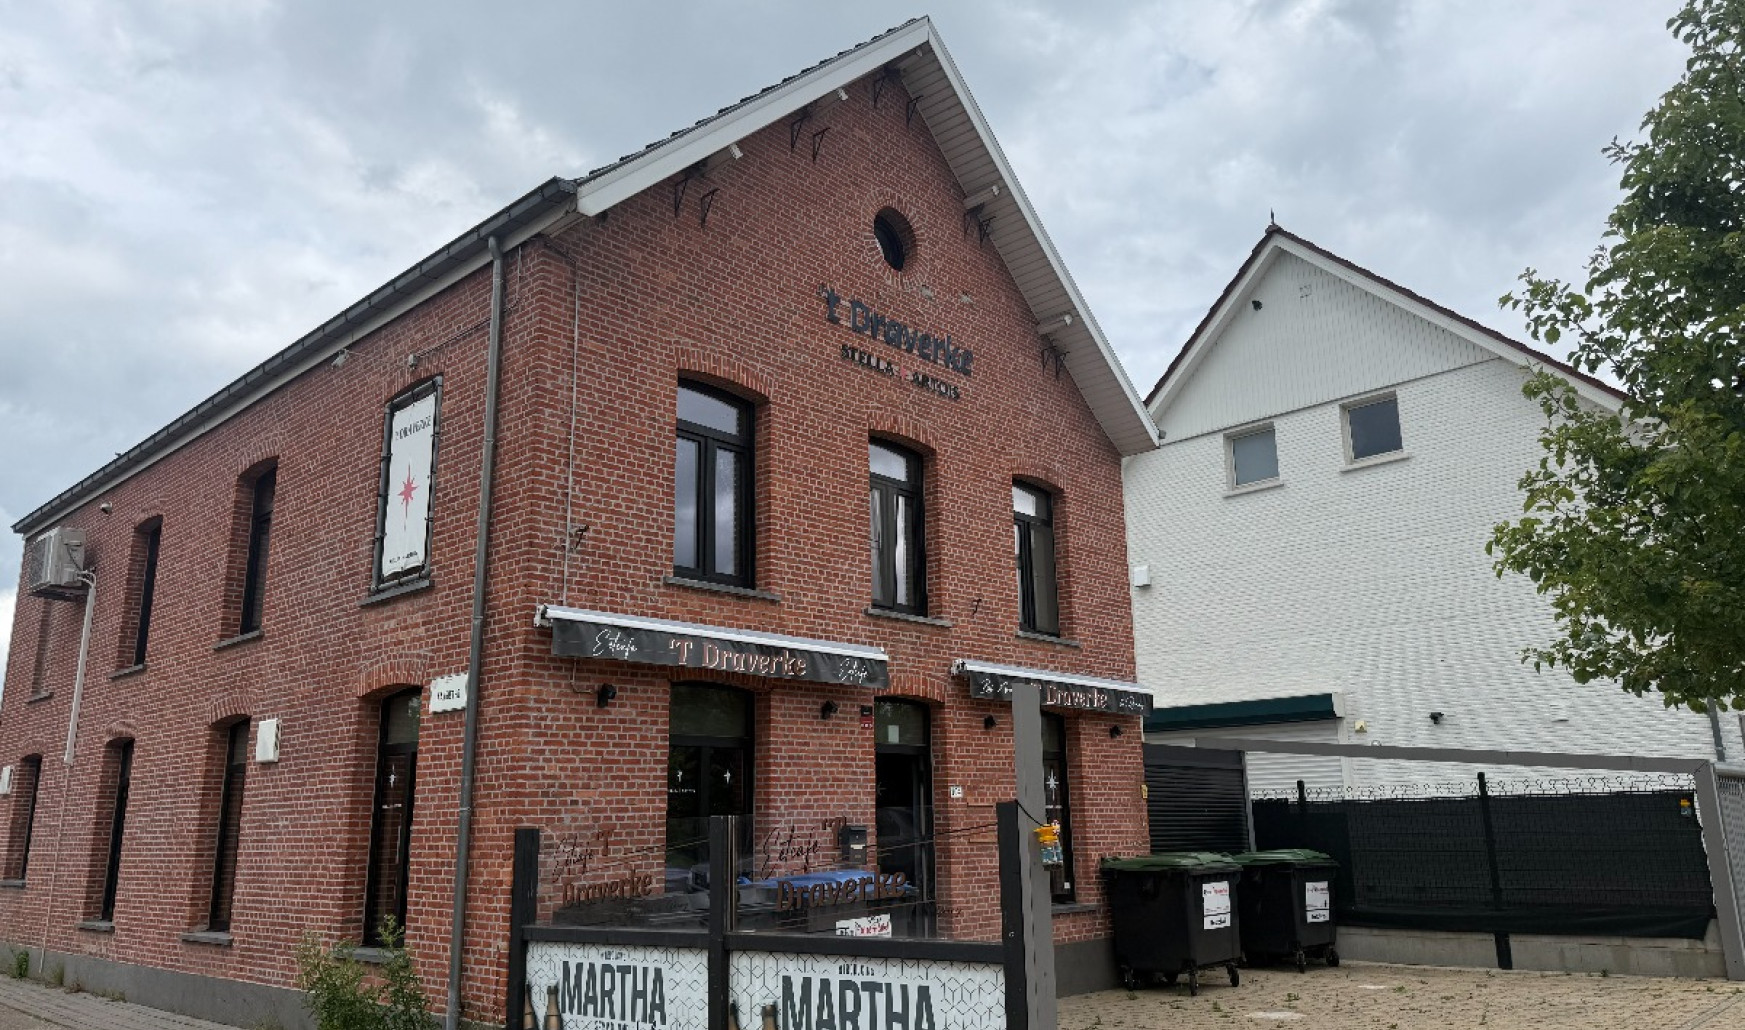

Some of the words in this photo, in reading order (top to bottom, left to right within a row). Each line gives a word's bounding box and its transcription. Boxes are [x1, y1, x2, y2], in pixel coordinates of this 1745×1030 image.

[850, 299, 974, 377] Draverke
[841, 343, 895, 377] STELLA
[912, 371, 960, 400] ARTOIS
[701, 642, 807, 676] Draverke
[561, 868, 653, 907] Draverke
[775, 865, 907, 912] Draverke
[560, 960, 667, 1026] MARTHA
[781, 974, 936, 1030] MARTHA
